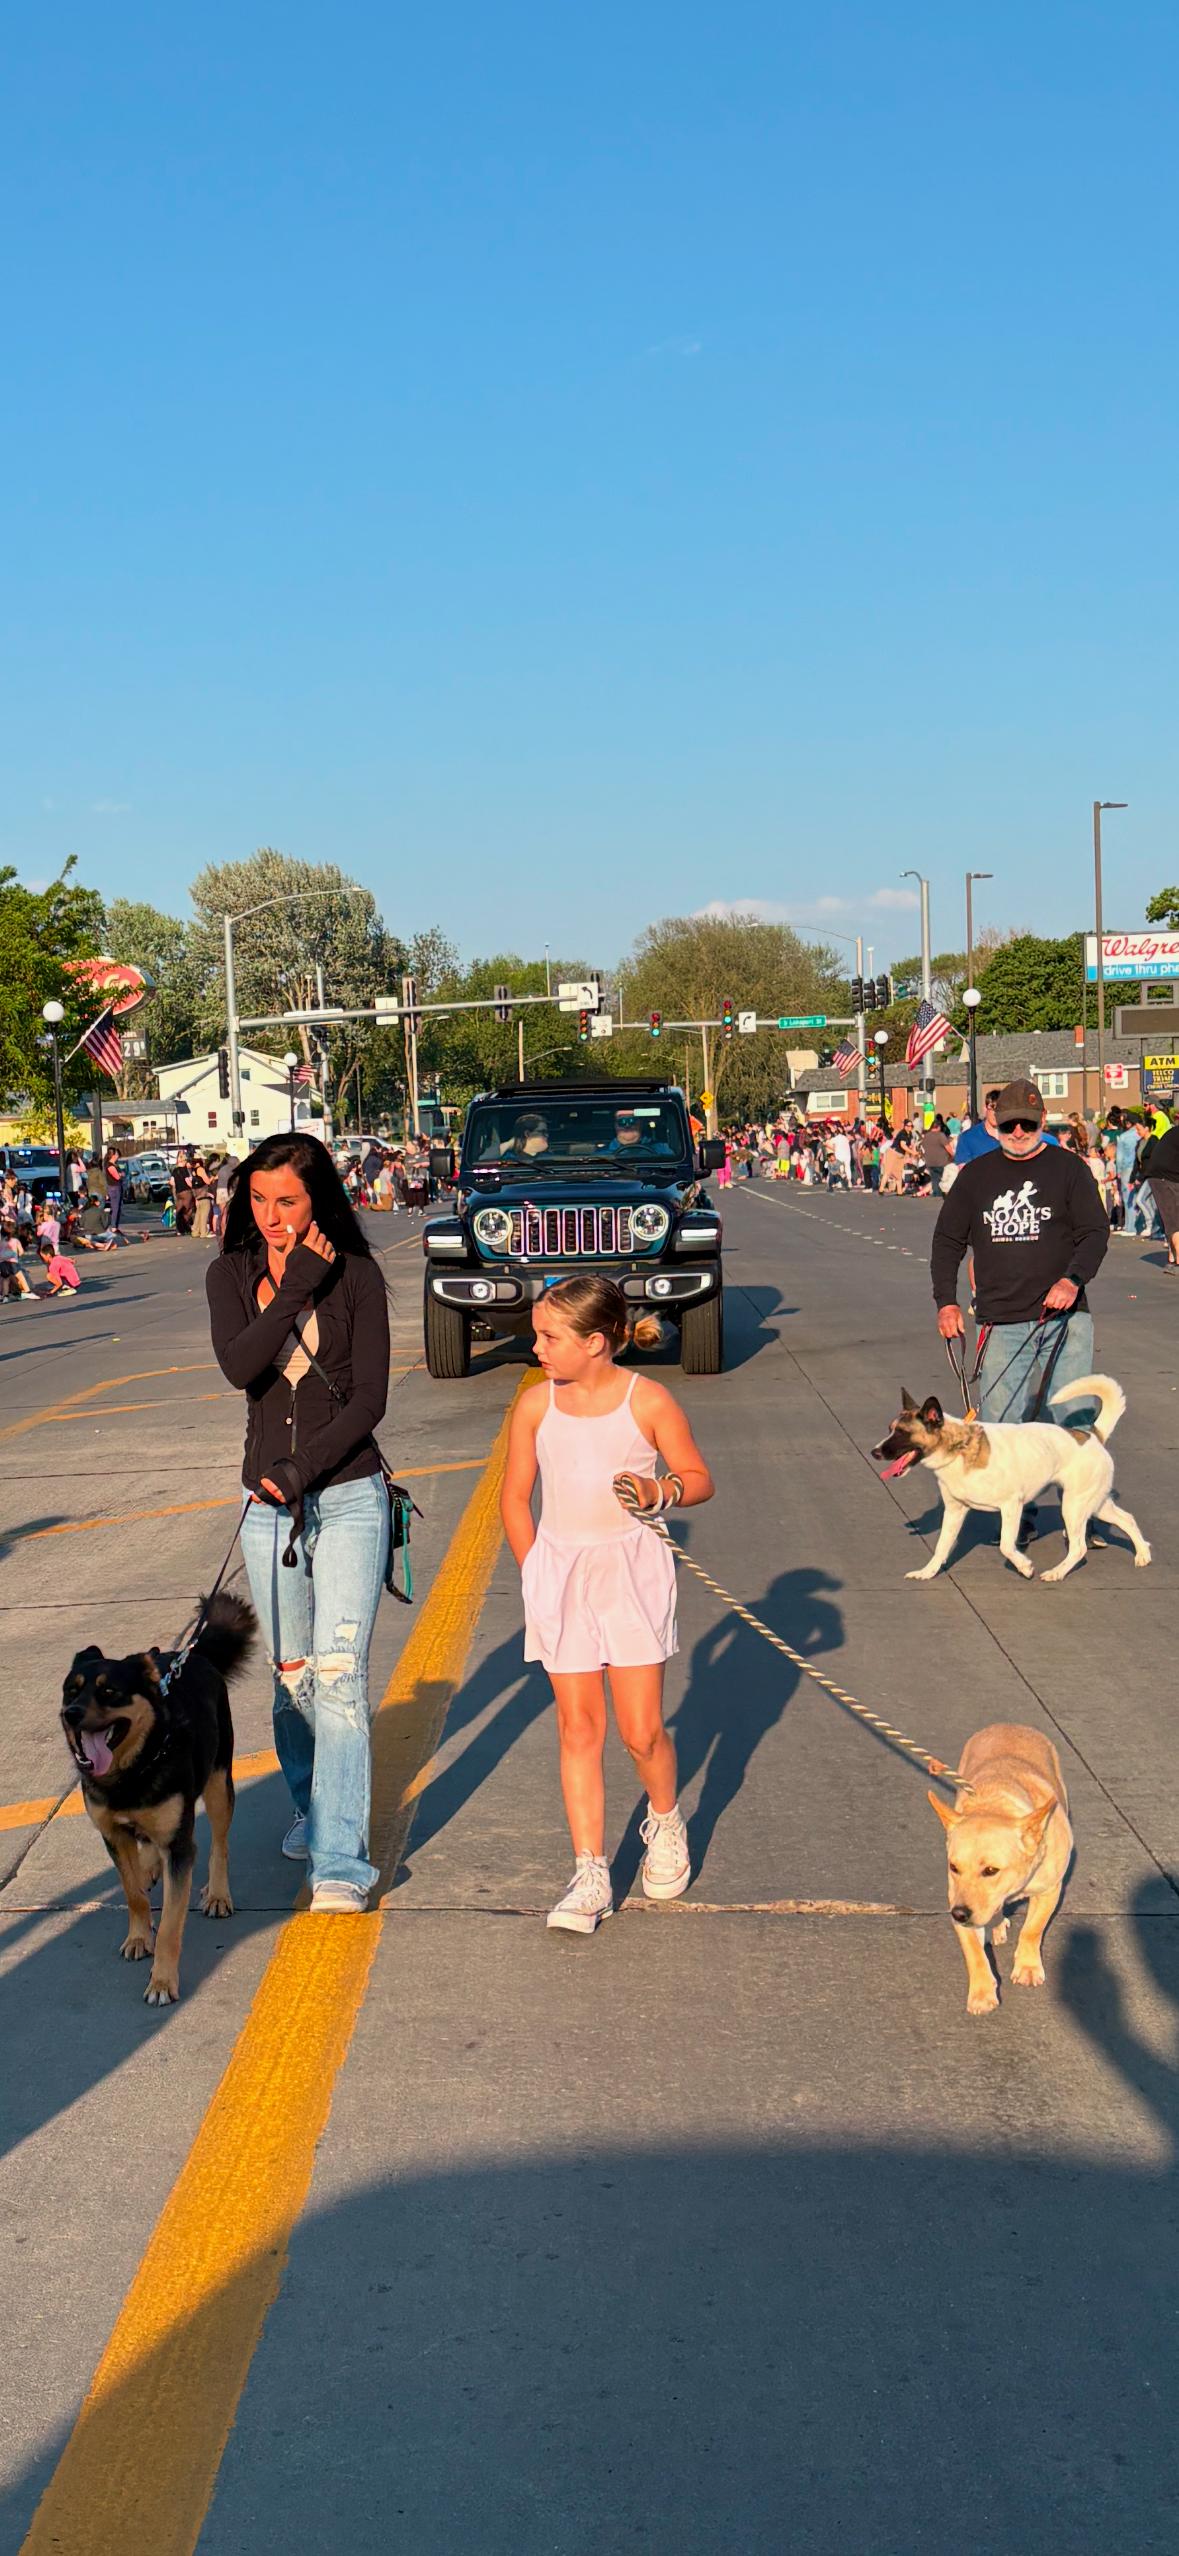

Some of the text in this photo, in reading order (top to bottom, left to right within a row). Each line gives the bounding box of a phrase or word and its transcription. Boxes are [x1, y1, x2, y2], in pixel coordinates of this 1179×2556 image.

[1104, 964, 1132, 976] drive
[1135, 963, 1157, 975] thru
[1150, 1057, 1175, 1066] ATM
[983, 1207, 1051, 1225] NOAH'S
[990, 1221, 1040, 1236] HOPE
